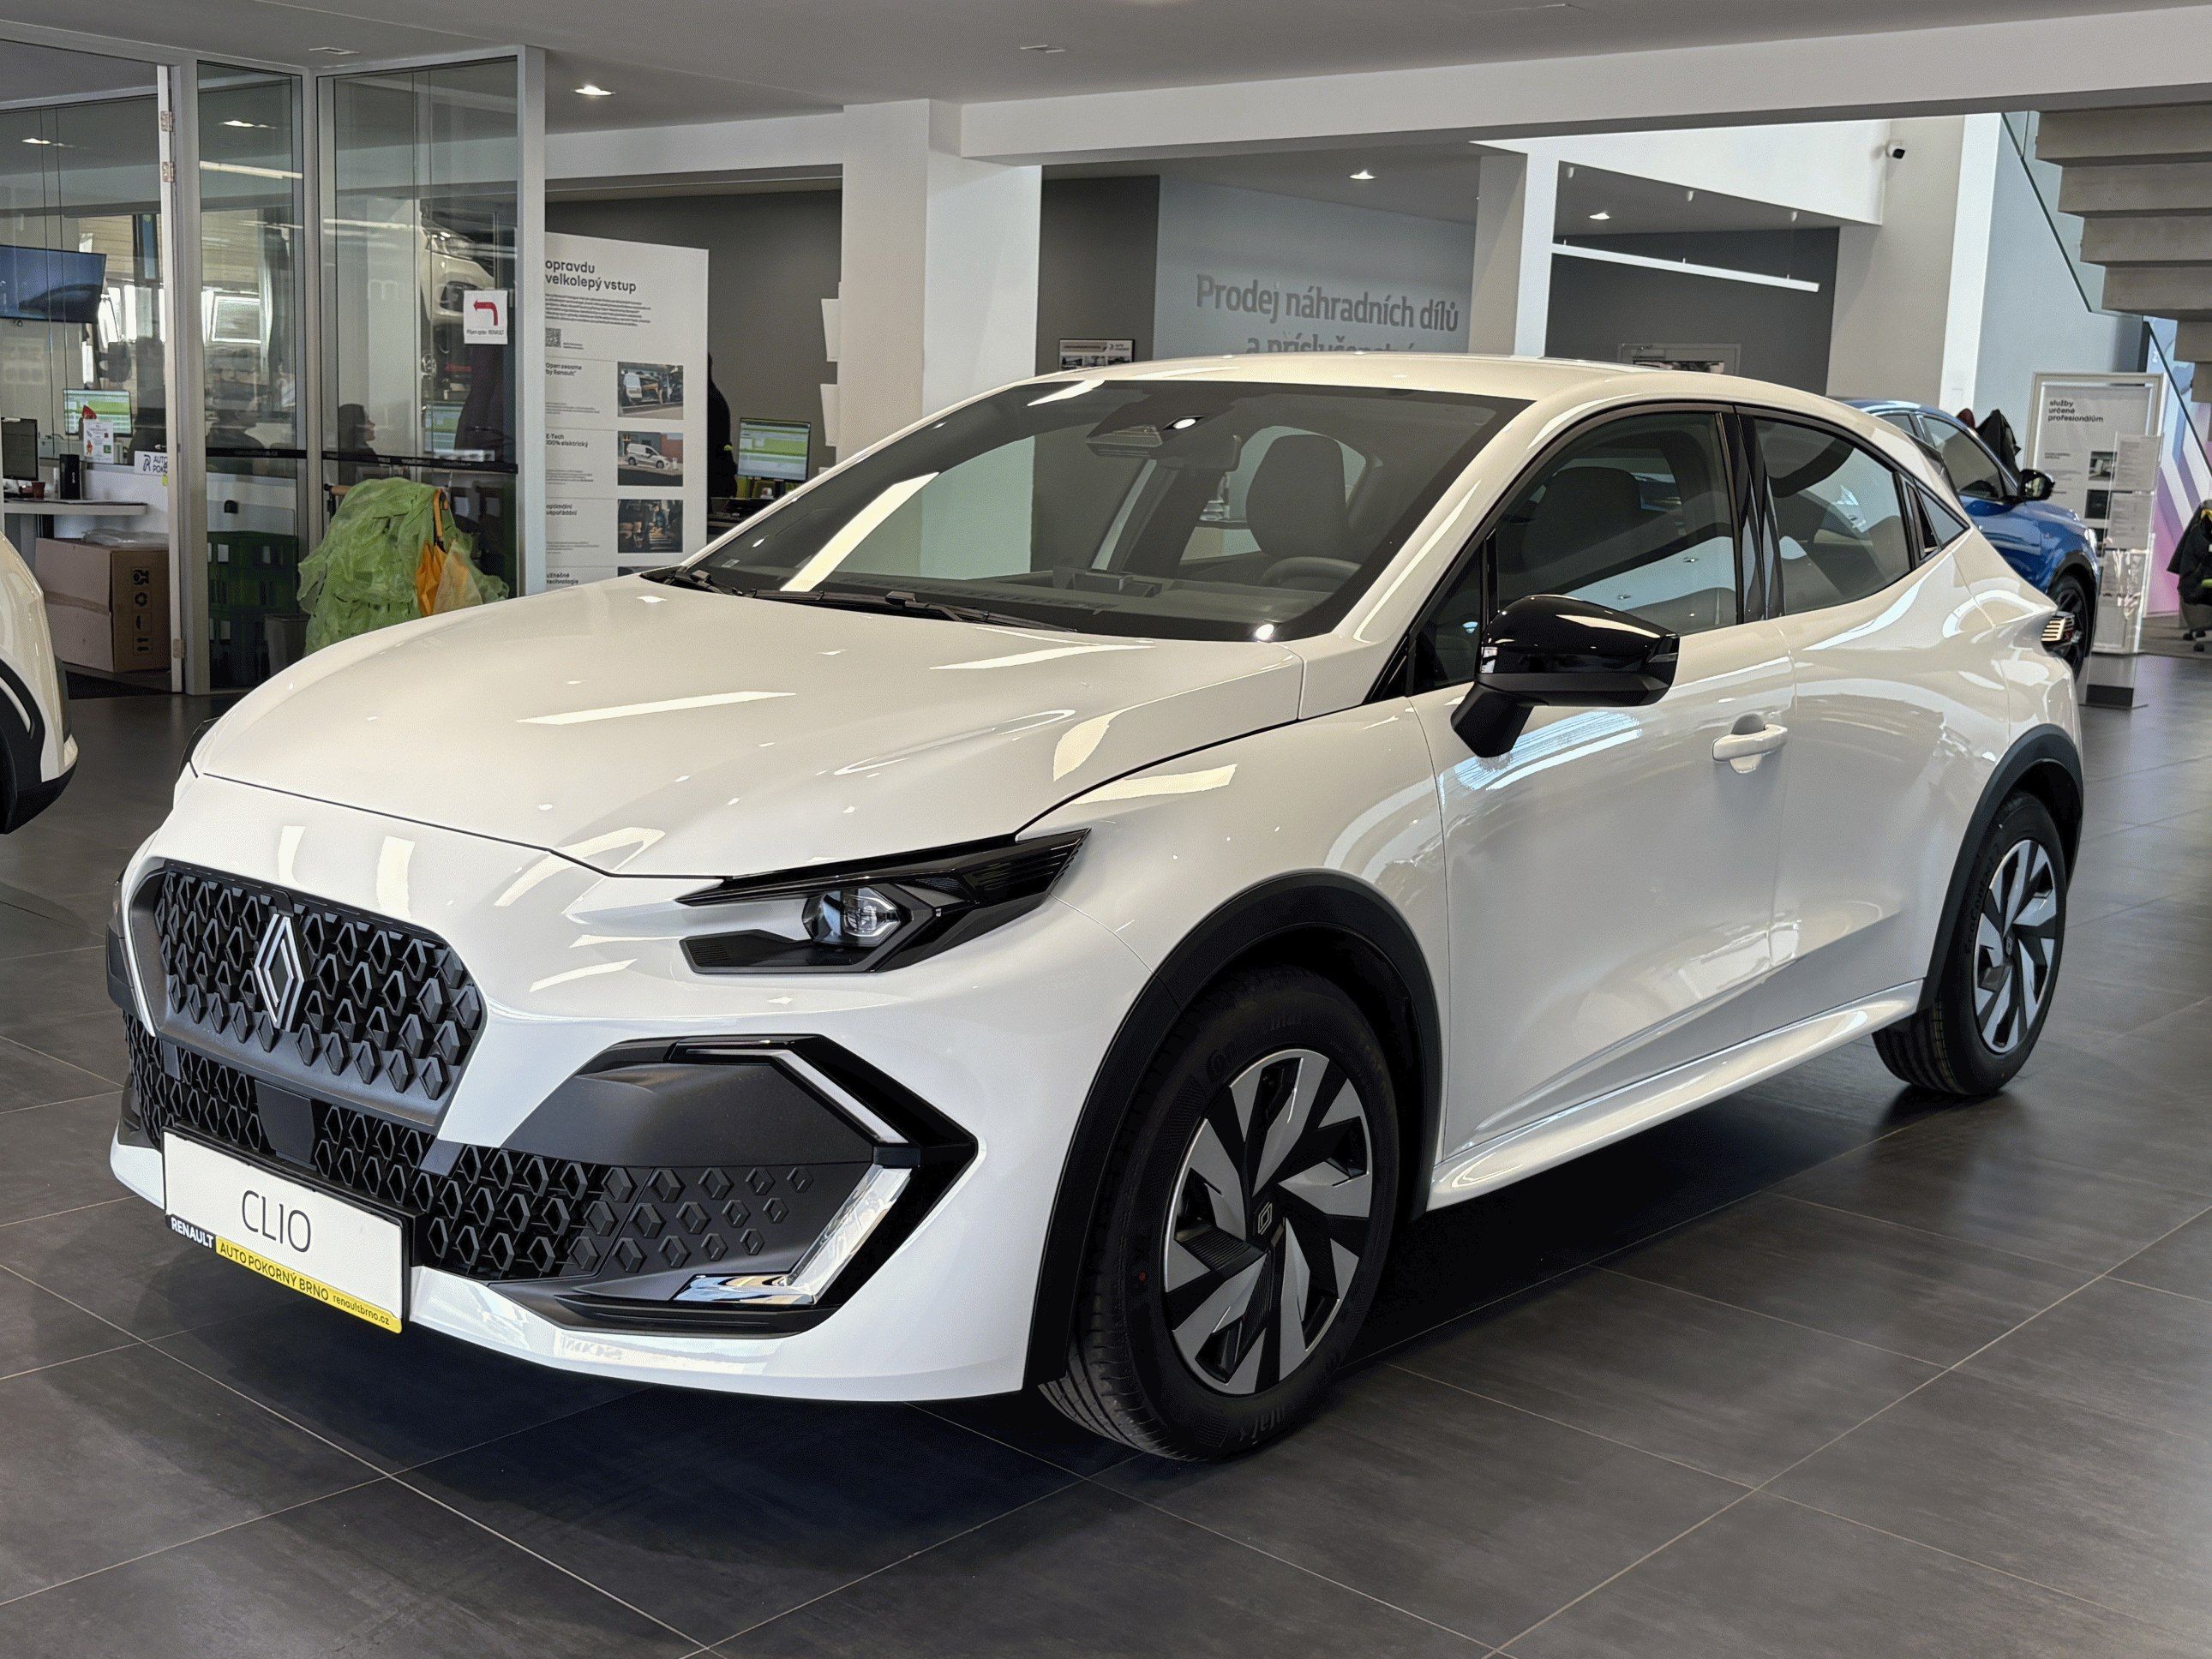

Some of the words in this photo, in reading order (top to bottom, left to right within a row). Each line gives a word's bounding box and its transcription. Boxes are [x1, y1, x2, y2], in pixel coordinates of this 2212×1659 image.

[545, 260, 595, 274] opravdu
[545, 273, 602, 291] velkolepý
[603, 279, 637, 295] vstup
[1196, 273, 1280, 324] Prodej
[1286, 285, 1414, 328] náhradních
[1419, 298, 1459, 332] dílů
[171, 1216, 214, 1249] RENAULT
[242, 1189, 312, 1253] CLIO
[219, 1242, 247, 1264] AUTO
[248, 1252, 297, 1287] POKORNÝ
[298, 1277, 330, 1301] BRNO
[333, 1293, 391, 1326] renaultbrno.cz
